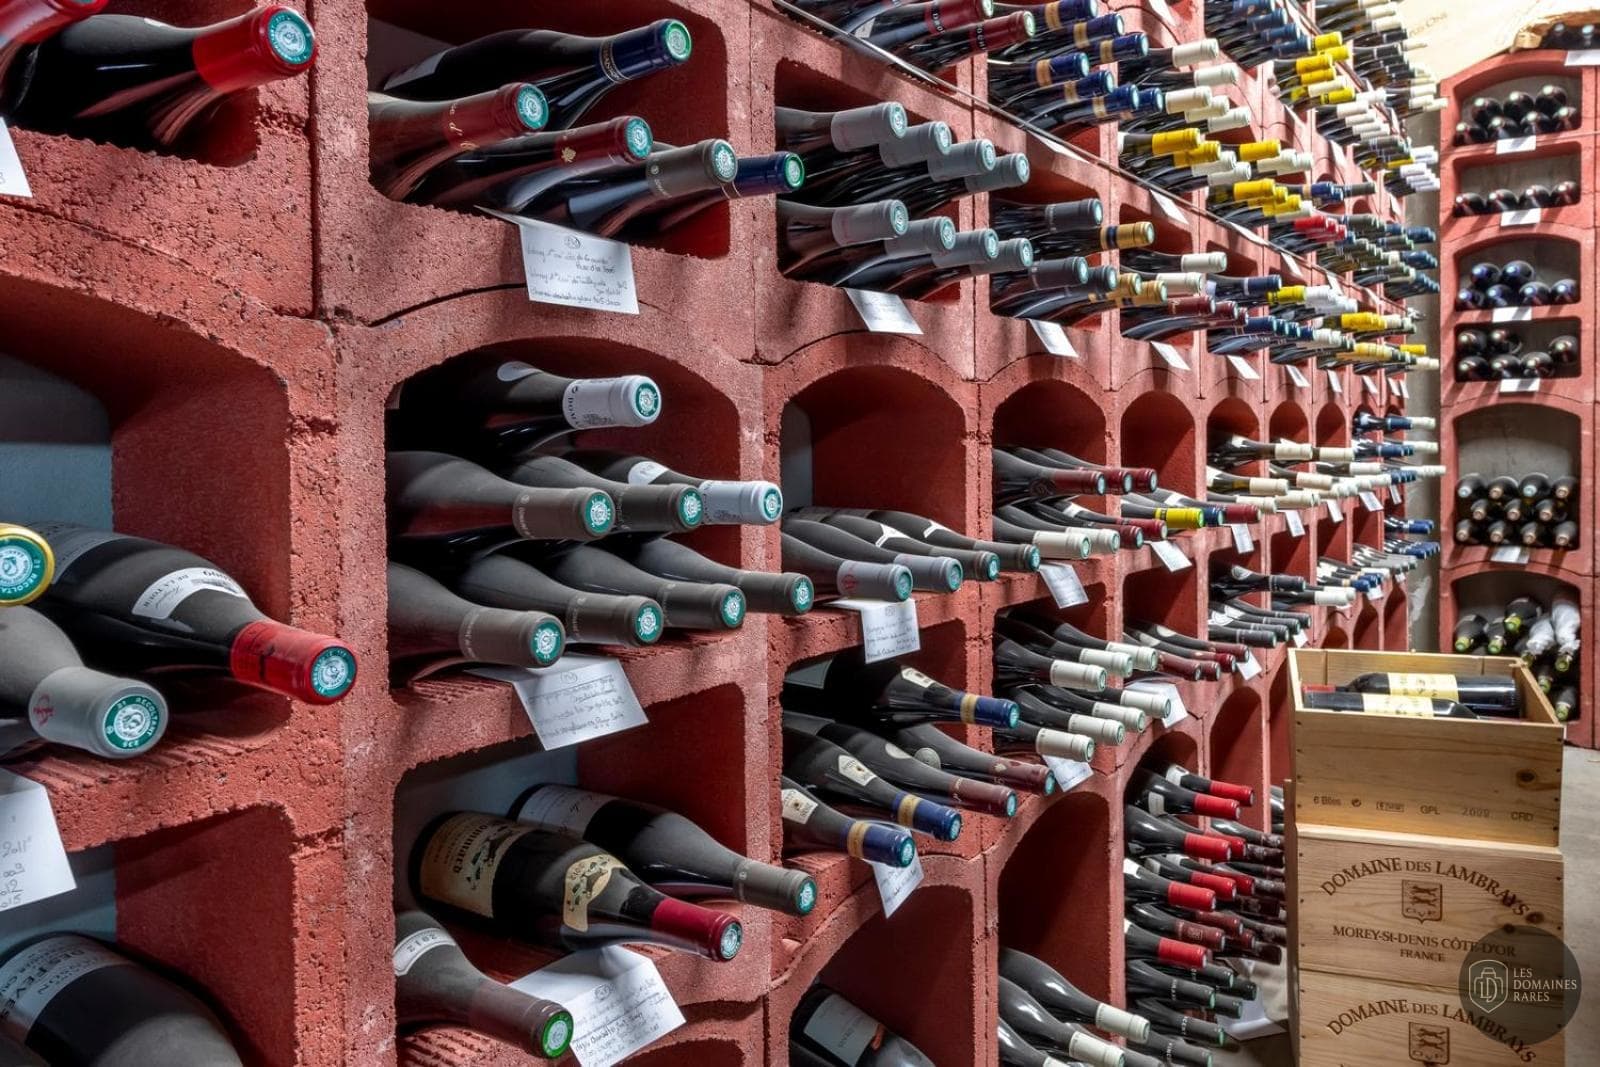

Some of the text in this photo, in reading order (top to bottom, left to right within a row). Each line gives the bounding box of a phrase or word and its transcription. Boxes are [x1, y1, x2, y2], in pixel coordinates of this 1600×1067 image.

[0, 573, 38, 594] RECOLTA
[1320, 857, 1530, 917] DOMAINE DES LAMBRAYS
[1400, 948, 1446, 962] FRANCE
[1327, 999, 1537, 1063] DOMAINE DES LAMBRAYS
